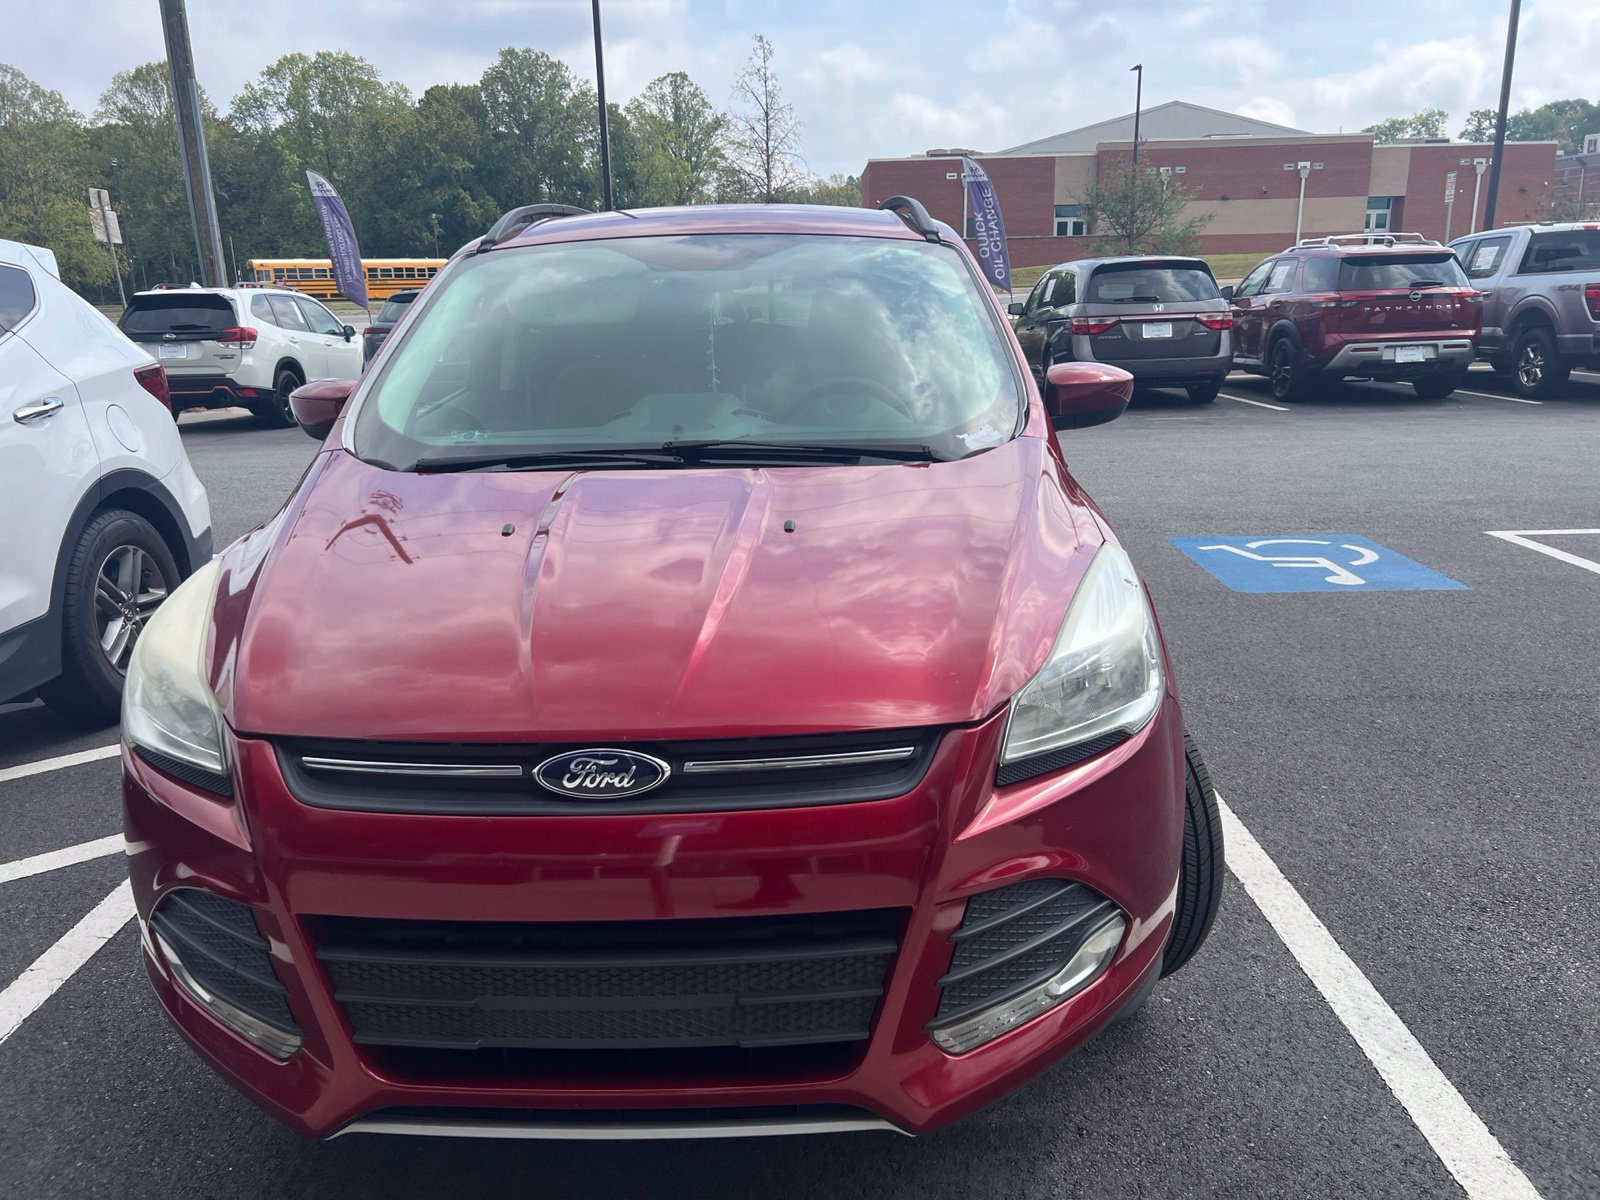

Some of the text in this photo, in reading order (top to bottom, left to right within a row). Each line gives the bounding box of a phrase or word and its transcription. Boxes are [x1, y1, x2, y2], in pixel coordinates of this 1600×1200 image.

[320, 204, 333, 239] Warranty
[974, 211, 990, 258] QUICK
[982, 188, 1006, 279] OIL CHANGE
[1363, 303, 1462, 313] PATHFINDER
[562, 757, 637, 789] Ford
